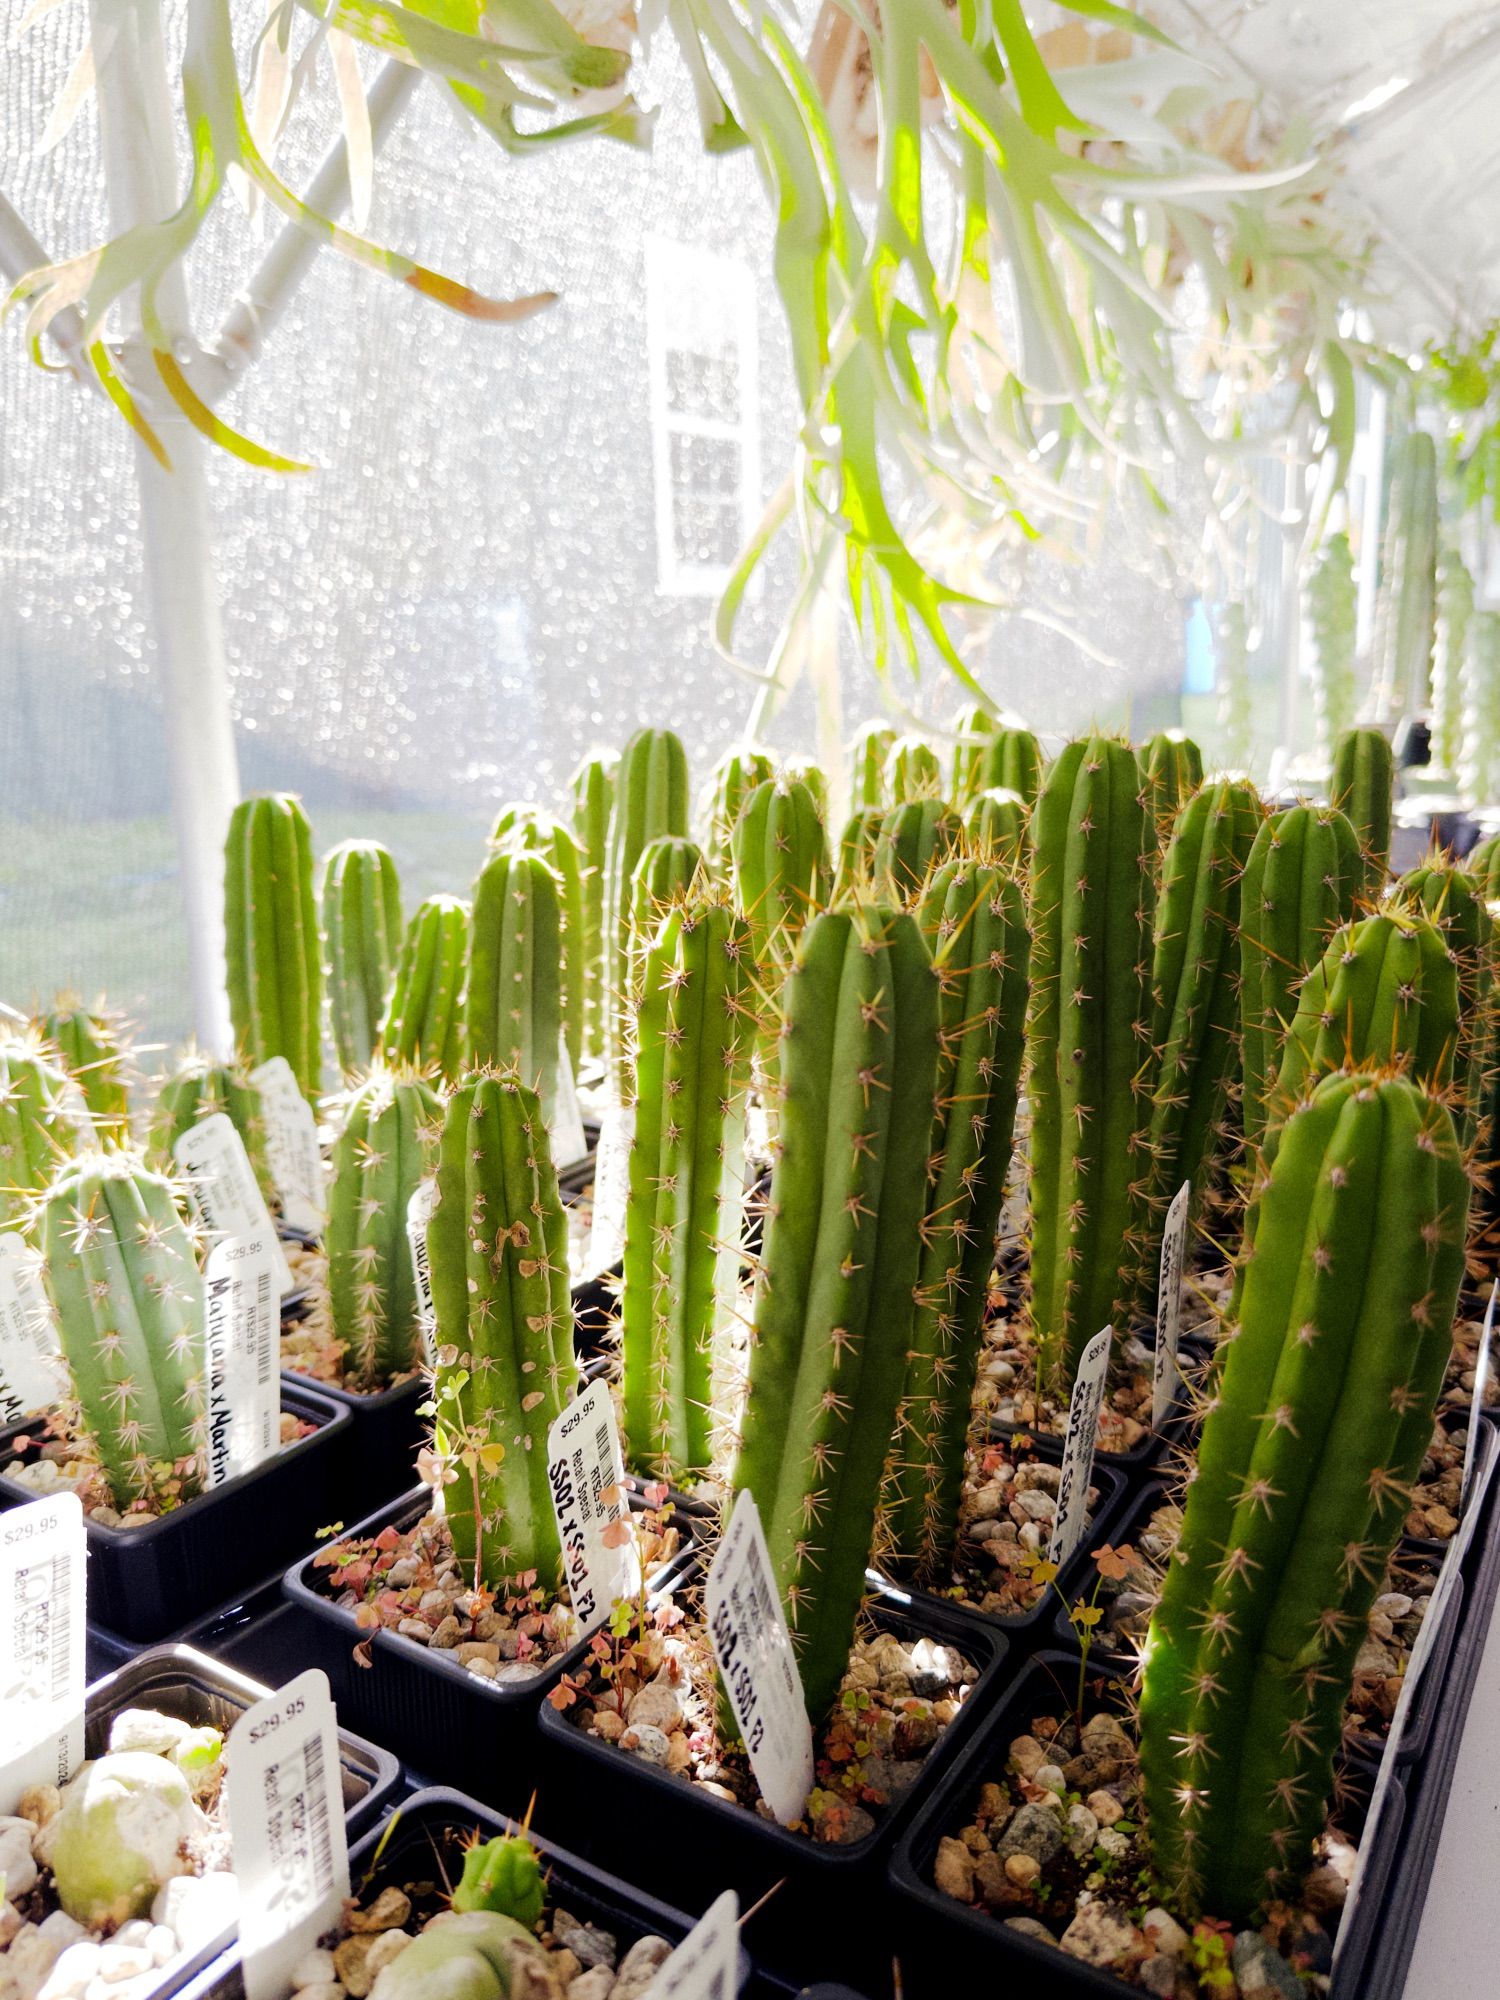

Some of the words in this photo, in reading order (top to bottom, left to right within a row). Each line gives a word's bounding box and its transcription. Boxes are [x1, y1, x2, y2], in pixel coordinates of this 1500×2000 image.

[225, 1241, 263, 1261] $29.95
[247, 1306, 256, 1355] RTS29.95
[211, 1394, 226, 1408] x
[560, 1397, 595, 1438] $29.95
[1067, 1381, 1086, 1445] SS02
[210, 1409, 233, 1484] Martin
[572, 1448, 586, 1484] Retail
[549, 1458, 575, 1519] SS02
[577, 1481, 592, 1523] Special
[4, 1515, 58, 1545] $29.95
[563, 1519, 578, 1537] x
[567, 1532, 589, 1592] SS01
[14, 1568, 29, 1608] Retail
[577, 1588, 596, 1623] F2
[14, 1611, 29, 1662] Special
[249, 1697, 305, 1744] $29.95
[264, 1763, 280, 1810] Retail
